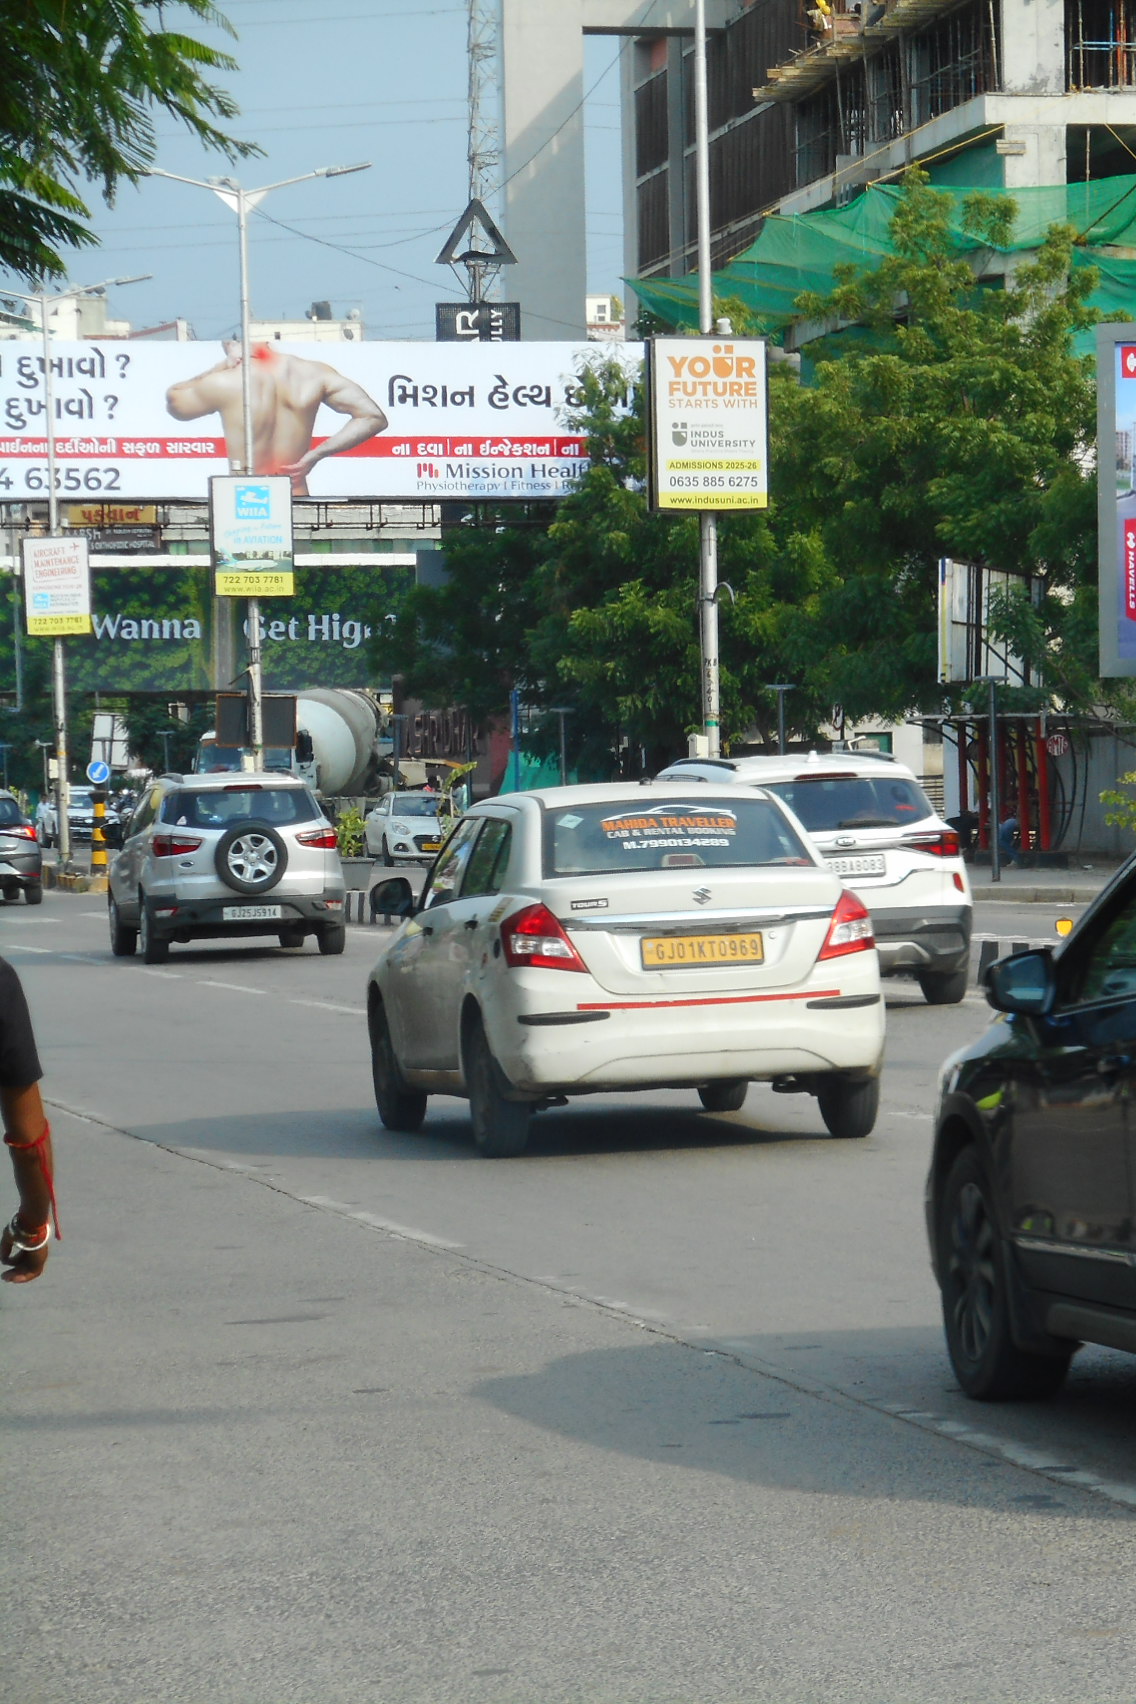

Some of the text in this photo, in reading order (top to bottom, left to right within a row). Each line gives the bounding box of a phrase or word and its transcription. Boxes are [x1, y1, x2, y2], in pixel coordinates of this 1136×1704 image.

[667, 353, 756, 379] YOUR
[388, 374, 475, 408] મિશન
[668, 381, 757, 397] FUTURE
[668, 398, 758, 409] STARTS WITH
[690, 430, 725, 439] INDUS
[690, 439, 756, 448] UNIVERSITY
[446, 462, 590, 479] Mission Healt
[669, 461, 757, 470] ADMISSIONS 2025-26
[24, 467, 121, 491] 63562
[669, 476, 758, 488] 0635 885 6275
[416, 480, 501, 493] Physiotherapy
[511, 480, 551, 491] Fitness
[670, 495, 759, 505] www.indusuni.ac.in
[243, 535, 284, 545] AVIATION
[224, 576, 241, 584] 722
[244, 576, 261, 584] 703
[1128, 551, 1136, 609] HAVELLS
[91, 612, 201, 640] Wanna
[243, 614, 300, 641] Get
[602, 816, 737, 831] MAHIDA TRAVELLER
[606, 827, 737, 839] CAB & RENTAL BOOKING
[655, 938, 760, 961] GJ01KT0969
